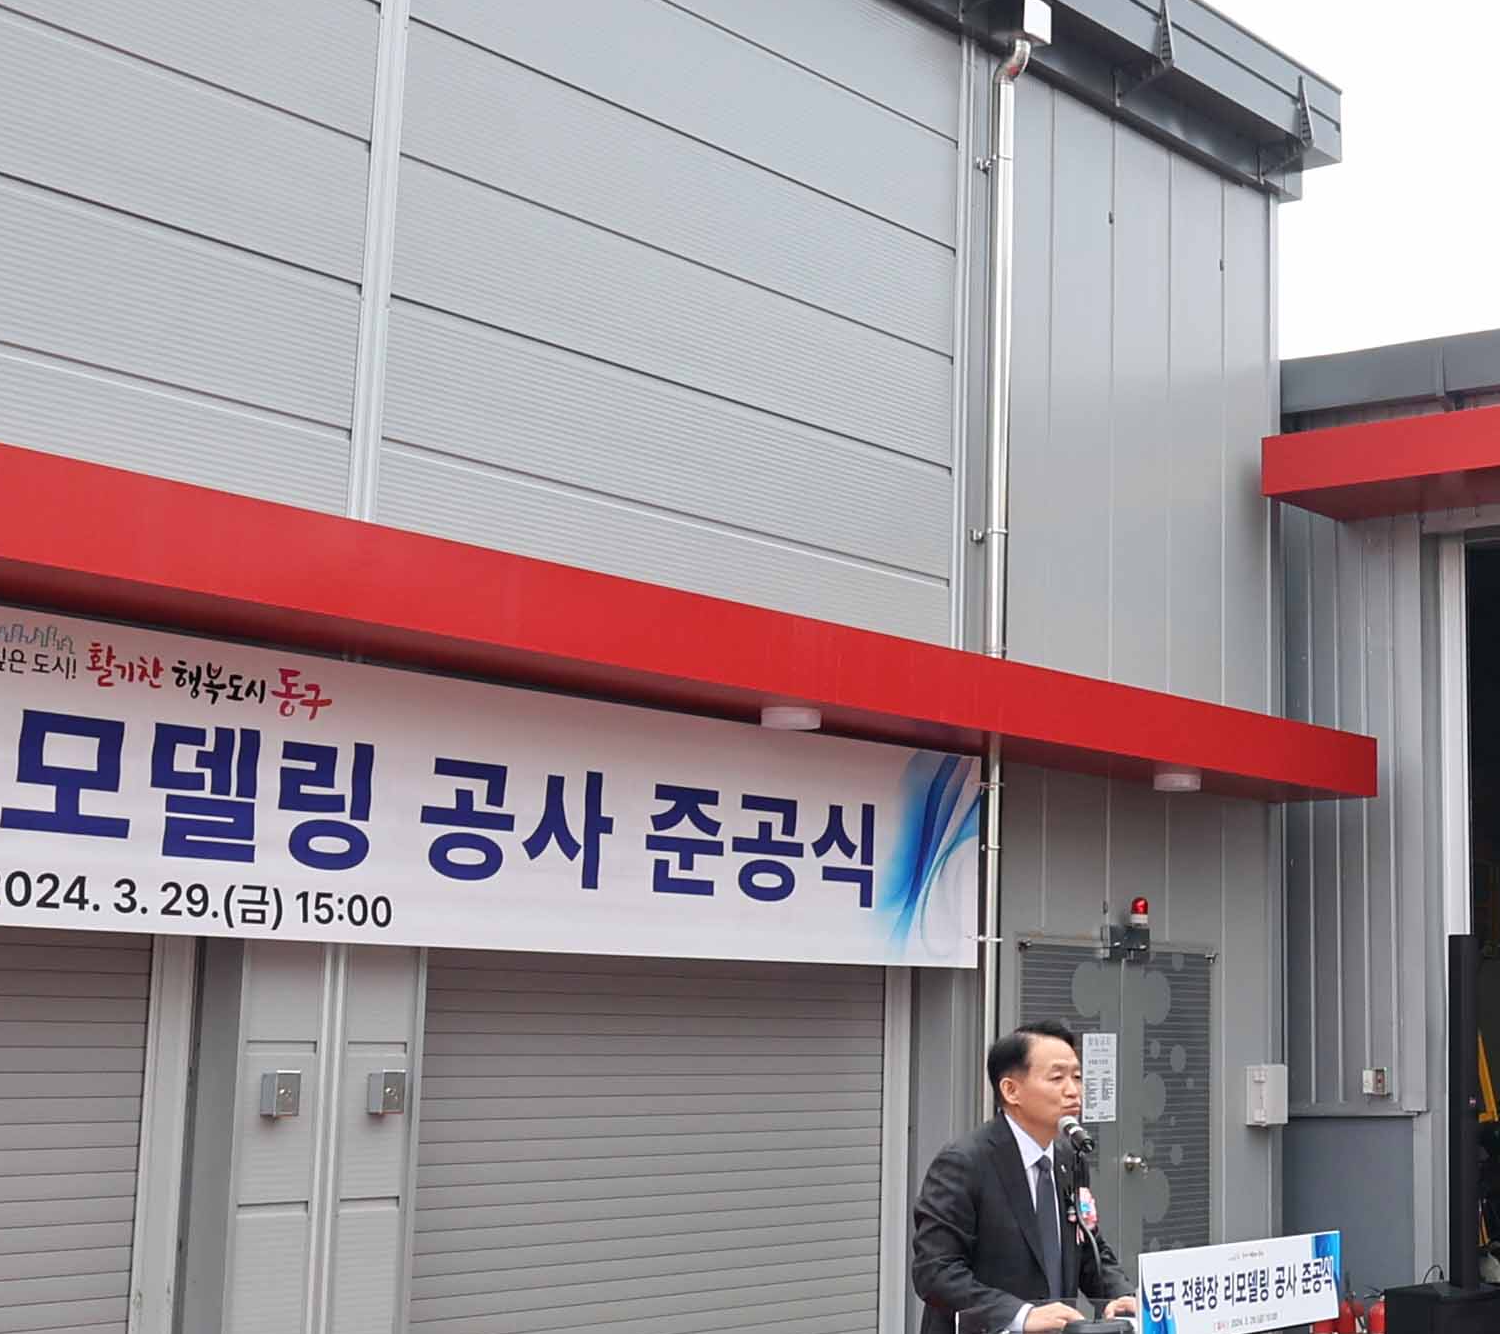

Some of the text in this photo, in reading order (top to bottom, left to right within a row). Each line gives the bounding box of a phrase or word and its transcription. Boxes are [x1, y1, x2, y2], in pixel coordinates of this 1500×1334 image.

[31, 653, 77, 680] 도시!
[86, 643, 164, 688] 활기찬
[172, 660, 266, 705] 행복도시
[272, 668, 333, 720] 동구
[420, 757, 613, 890] 공사
[645, 787, 876, 909] 준공식
[113, 878, 148, 915] 3.
[160, 881, 283, 931] 29.(금)
[296, 891, 392, 928] 15:00
[1151, 1257, 1334, 1318] 동구 적환장 리모델링 공사 준공식
